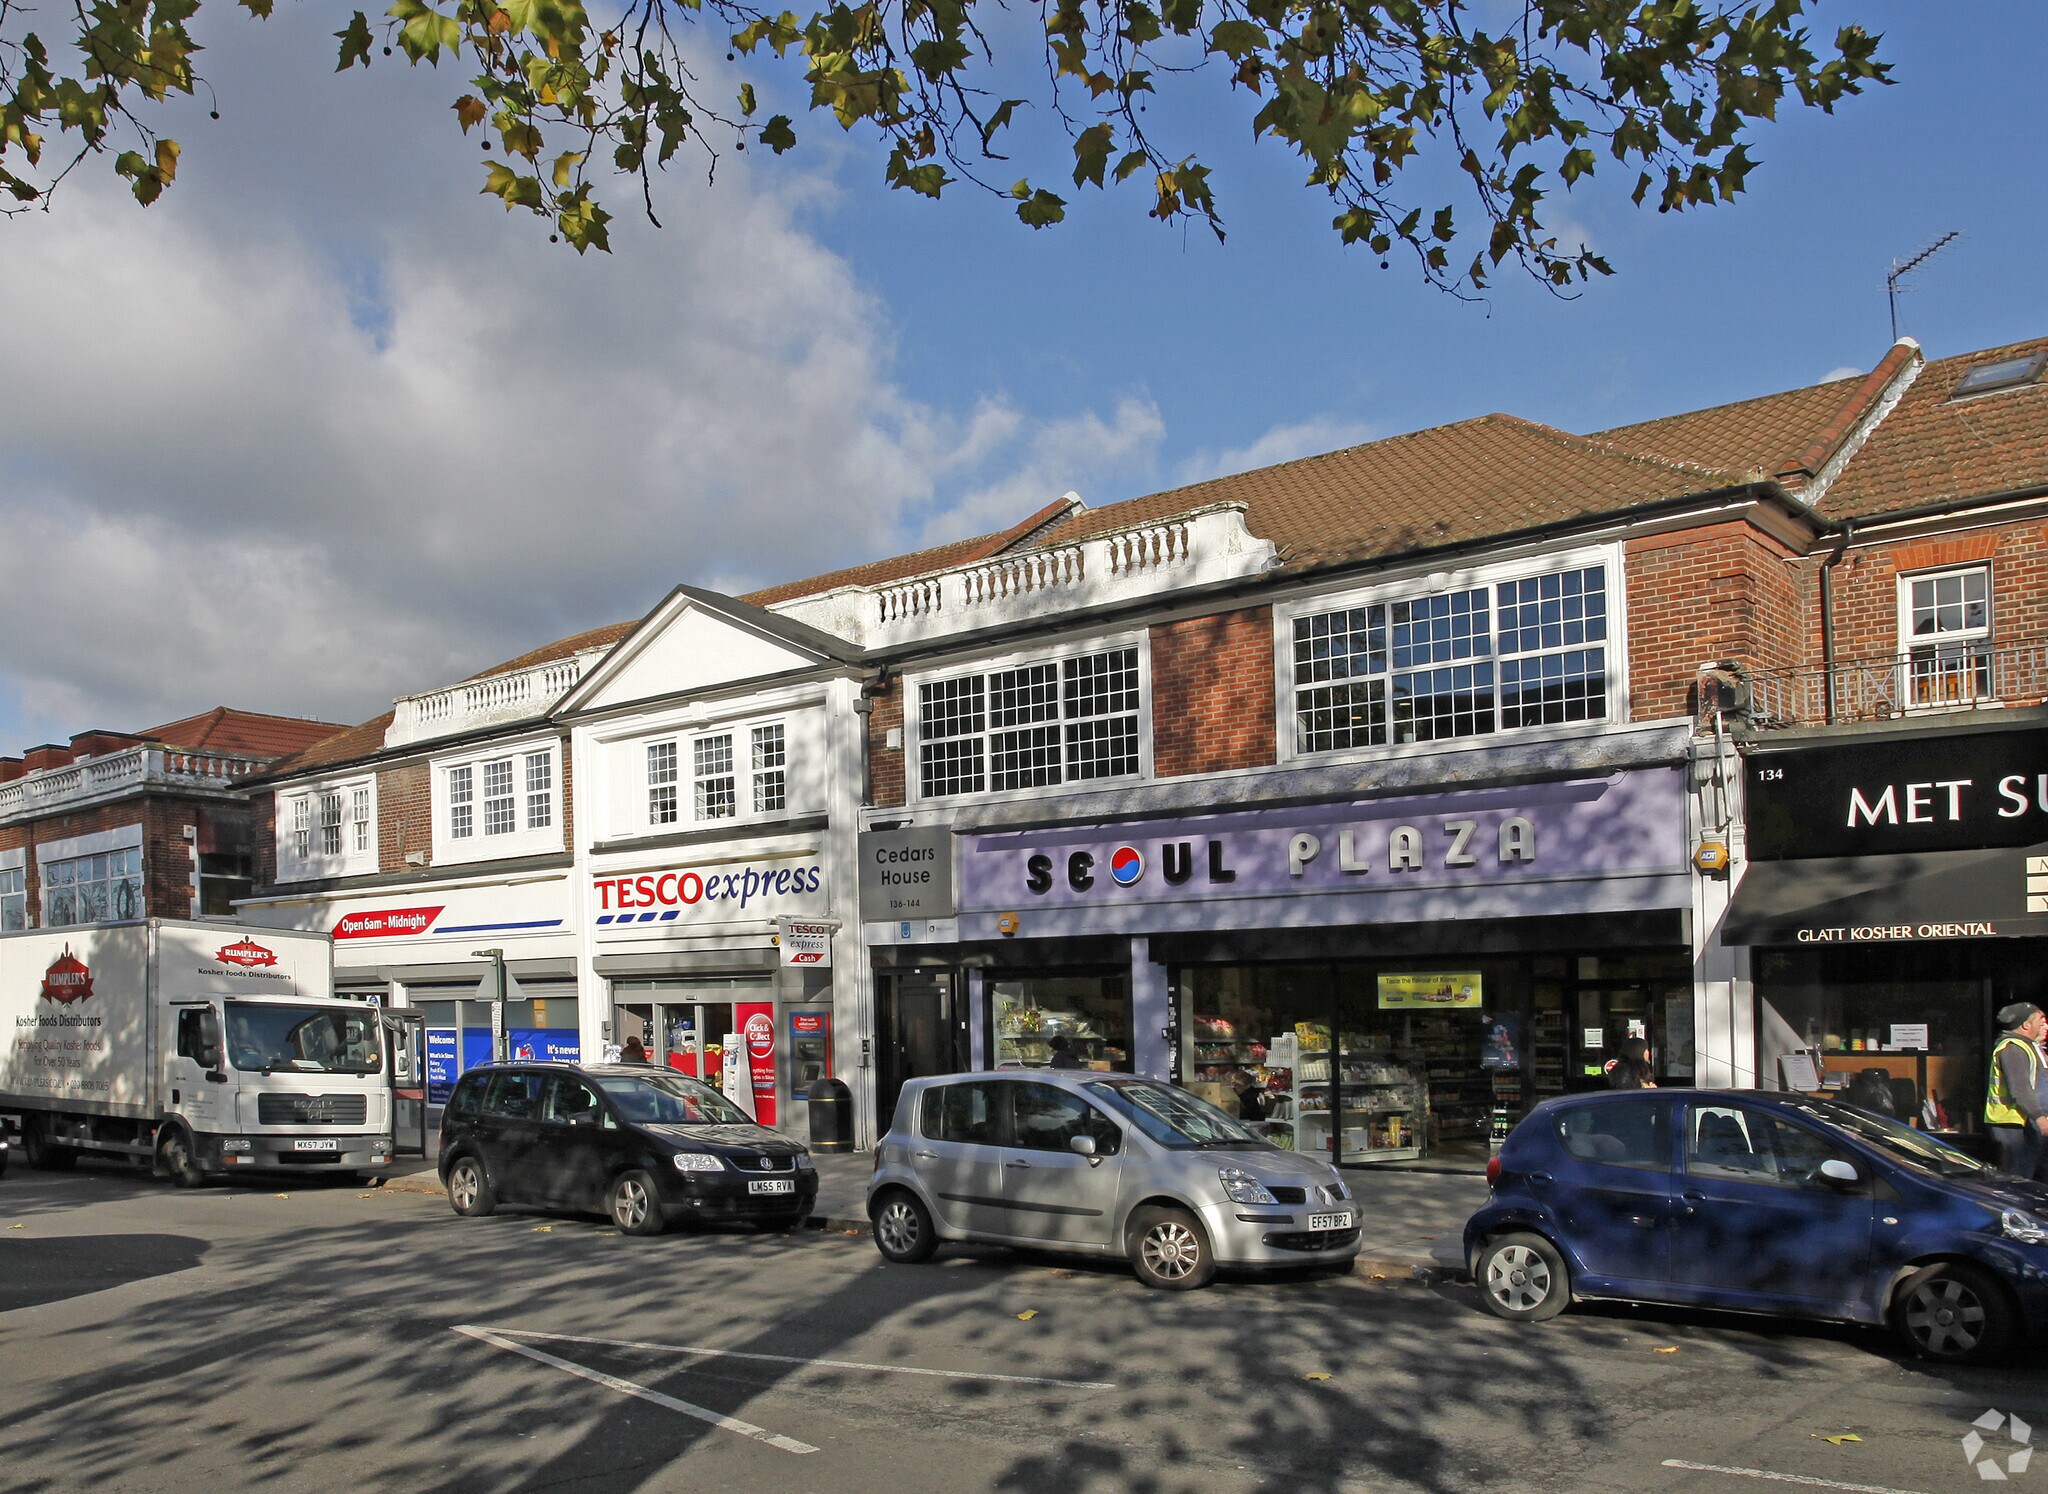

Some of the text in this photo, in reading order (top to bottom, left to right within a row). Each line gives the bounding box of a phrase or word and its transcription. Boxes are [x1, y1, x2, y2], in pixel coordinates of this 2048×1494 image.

[1758, 768, 1784, 781] 134
[1847, 779, 1974, 828] MET
[1289, 816, 1537, 875] PLAZA
[876, 847, 935, 864] Cedars
[1701, 852, 1716, 861] ADT
[881, 869, 931, 886] House
[594, 865, 821, 910] TESCO express
[889, 899, 921, 909] 136-144
[341, 919, 364, 934] Open
[364, 917, 382, 930] 6am
[387, 913, 427, 930] Midnight
[788, 924, 825, 935] TESCO
[1797, 922, 1997, 943] GLATT KOSHER ORIENTAL
[790, 940, 824, 951] express
[225, 948, 269, 959] RUMPLER'S
[798, 954, 816, 962] Cash
[49, 972, 86, 986] RUMPLER'S
[197, 968, 224, 976] Kosher
[248, 971, 292, 981] Distributors
[15, 1014, 102, 1027] Kosher Foods Distributors
[749, 1024, 764, 1032] Click
[428, 1035, 455, 1045] Welcome
[547, 1044, 580, 1055] It's never
[751, 1181, 792, 1192] LM55 RVA
[1312, 1214, 1348, 1228] EF57 BPZ
